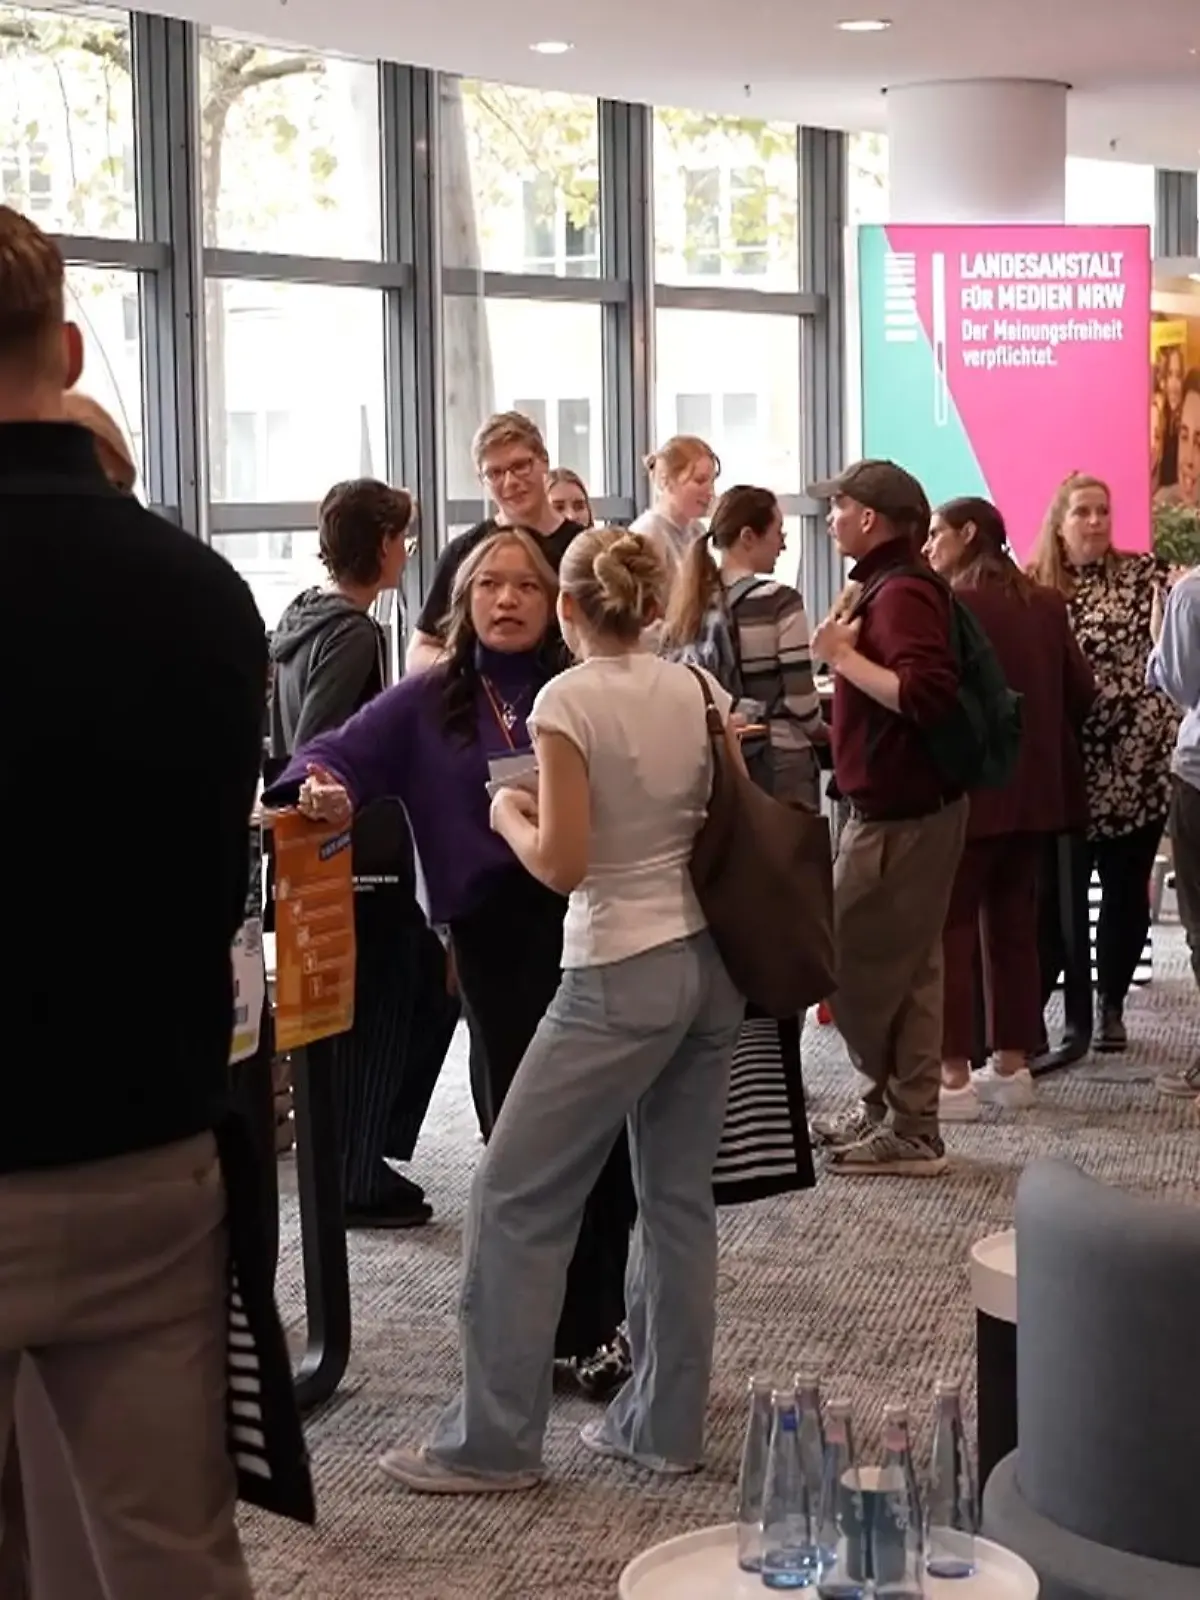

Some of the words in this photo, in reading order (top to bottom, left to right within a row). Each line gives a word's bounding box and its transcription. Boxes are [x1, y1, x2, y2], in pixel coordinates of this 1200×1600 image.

[961, 252, 1123, 278] LANDESANSTALT
[961, 286, 994, 310] FÜR
[998, 284, 1073, 310] MEDIEN
[1077, 283, 1125, 309] NRW
[962, 319, 989, 341] Der
[995, 319, 1123, 344] Meinungsfreiheit
[962, 346, 1057, 369] verpflichtet.
